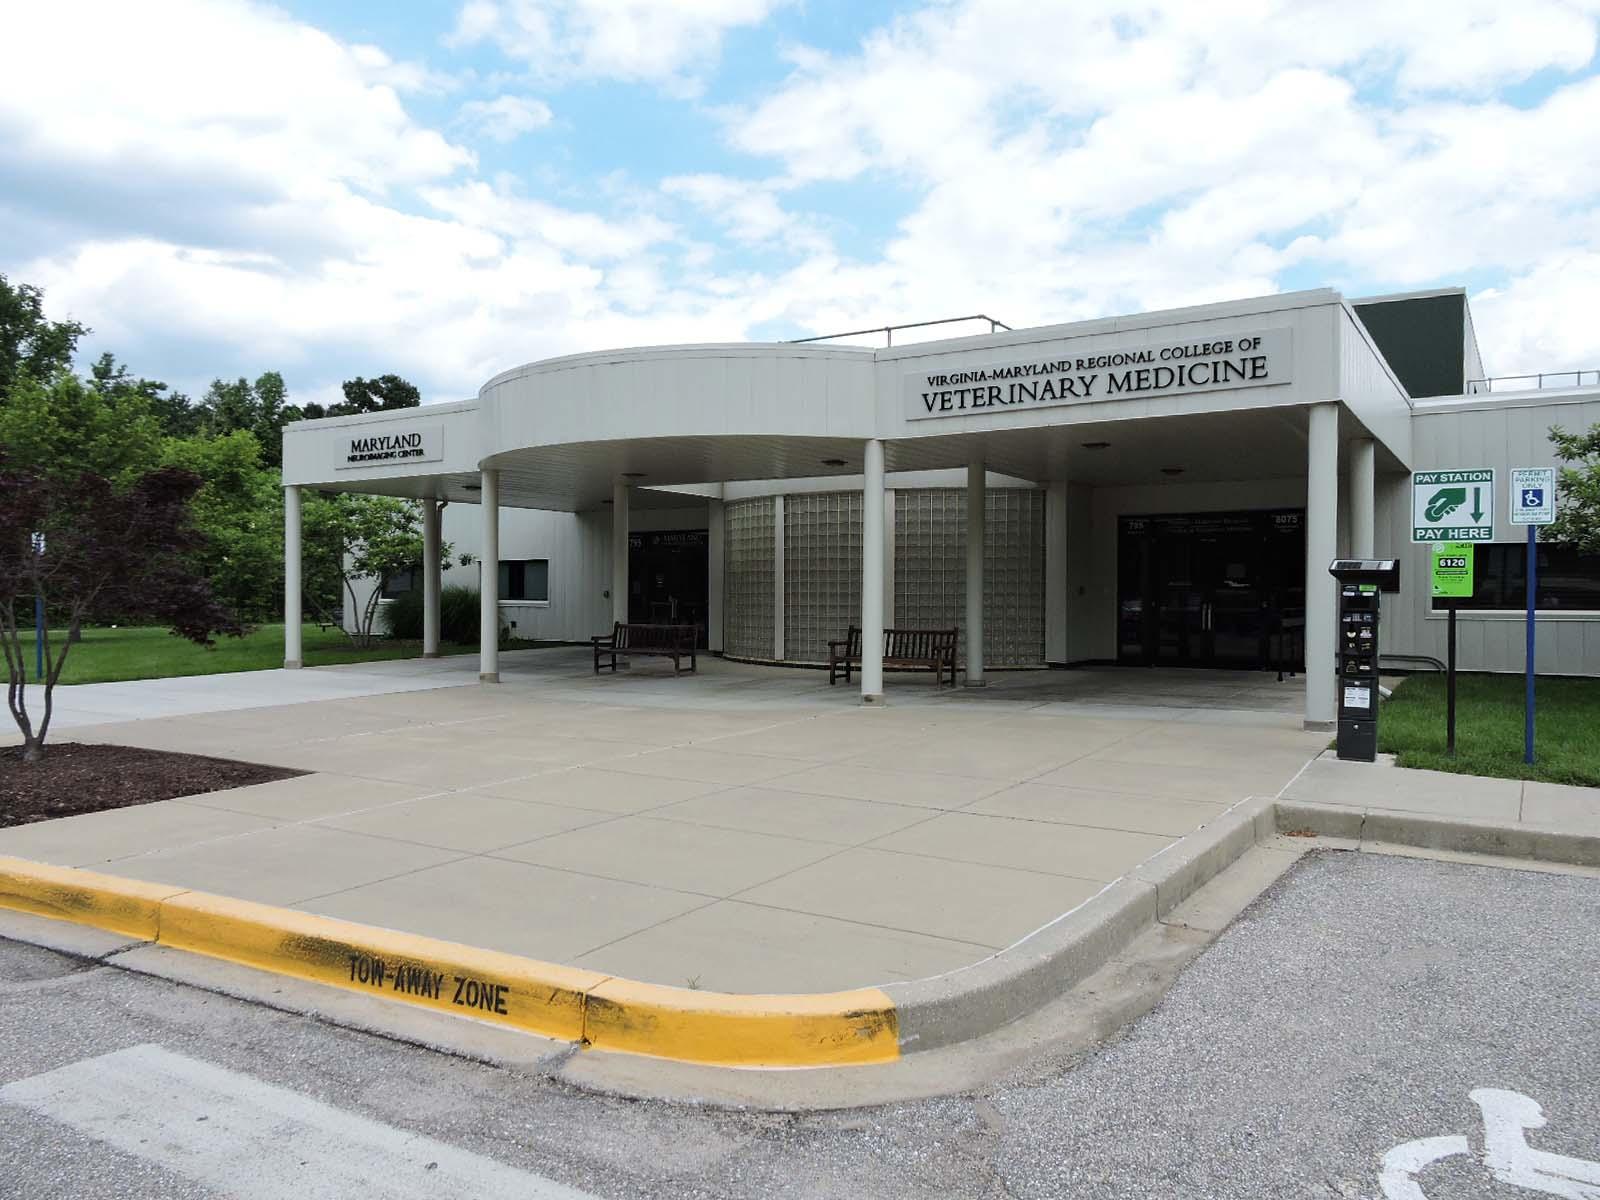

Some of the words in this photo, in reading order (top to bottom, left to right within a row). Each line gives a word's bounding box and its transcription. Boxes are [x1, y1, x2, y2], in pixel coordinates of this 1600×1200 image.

[927, 360, 1072, 387] VIRGINIA-MARYLAND
[1075, 350, 1155, 371] REGIONAL
[1160, 341, 1233, 361] COLLEGE
[1238, 337, 1262, 352] OF
[922, 375, 1098, 413] VETERINARY
[1106, 355, 1269, 395] MEDICINE
[351, 433, 421, 453] MARYLAND
[397, 449, 424, 458] CENTER
[1416, 474, 1437, 483] PAY
[1440, 472, 1491, 482] STATION
[1416, 529, 1443, 539] PAY
[1448, 528, 1490, 539] HERE
[1439, 559, 1465, 567] 6120
[350, 956, 444, 1000] TOW-AWAY
[452, 975, 509, 1015] ZONE
